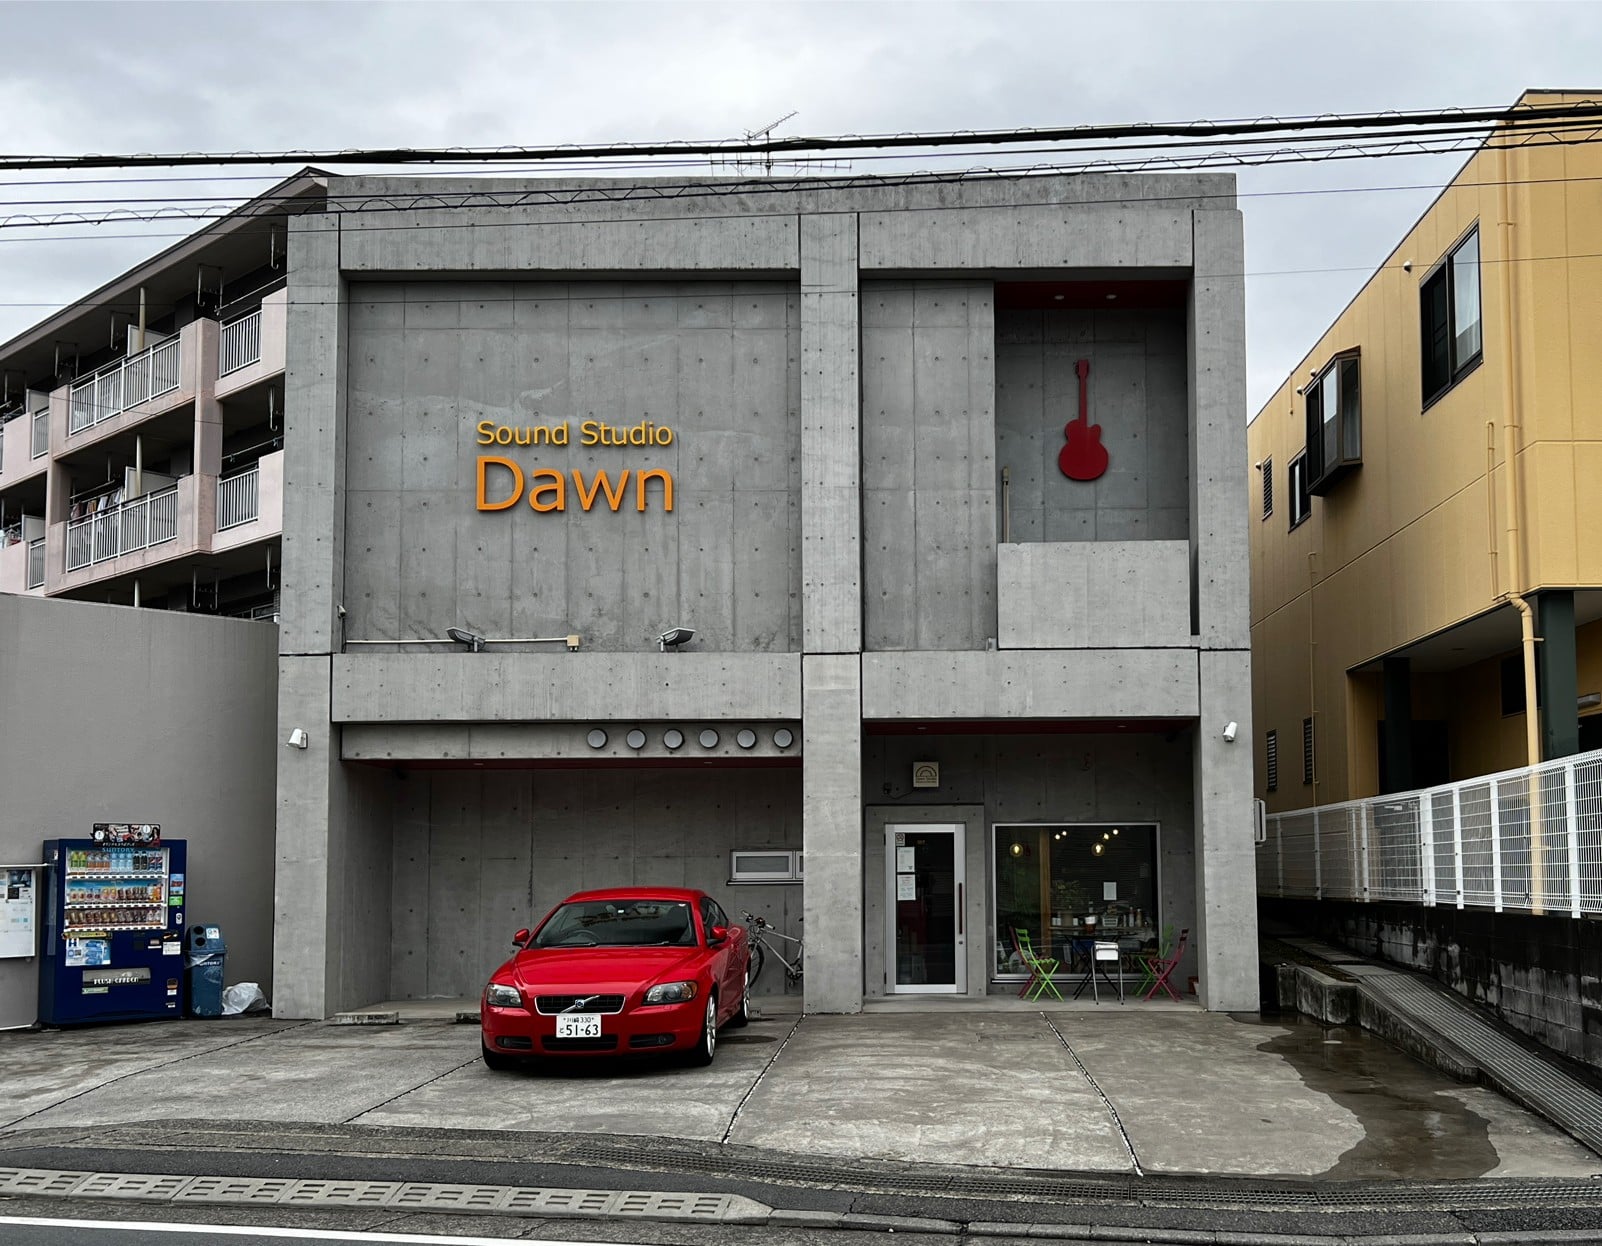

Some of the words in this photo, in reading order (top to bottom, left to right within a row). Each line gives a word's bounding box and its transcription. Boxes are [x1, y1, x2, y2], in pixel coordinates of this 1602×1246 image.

[476, 420, 569, 446] Sound
[580, 420, 673, 446] Studio
[476, 455, 674, 512] Dawn
[566, 1024, 599, 1036] 51-63
